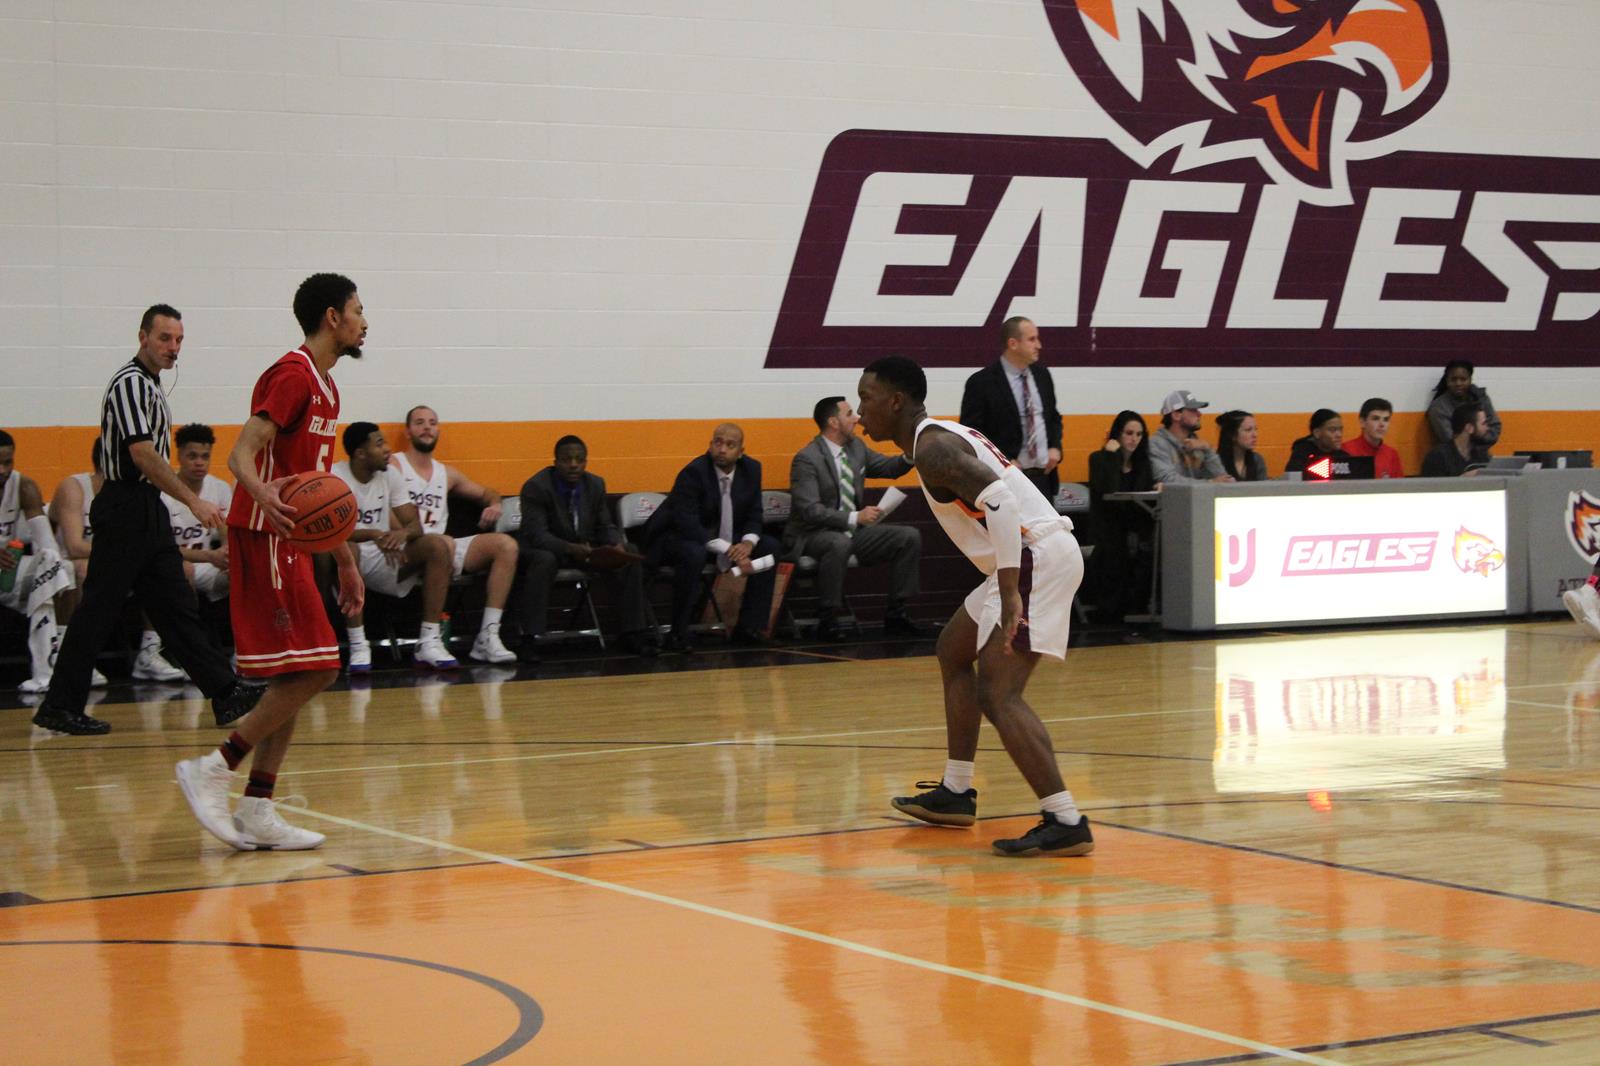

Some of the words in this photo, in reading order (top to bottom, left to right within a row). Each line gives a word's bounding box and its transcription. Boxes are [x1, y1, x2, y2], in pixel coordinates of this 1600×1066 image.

[822, 171, 1600, 331] EAGLES
[408, 490, 442, 508] POST
[357, 507, 383, 524] OST
[1287, 537, 1435, 571] EAGLES
